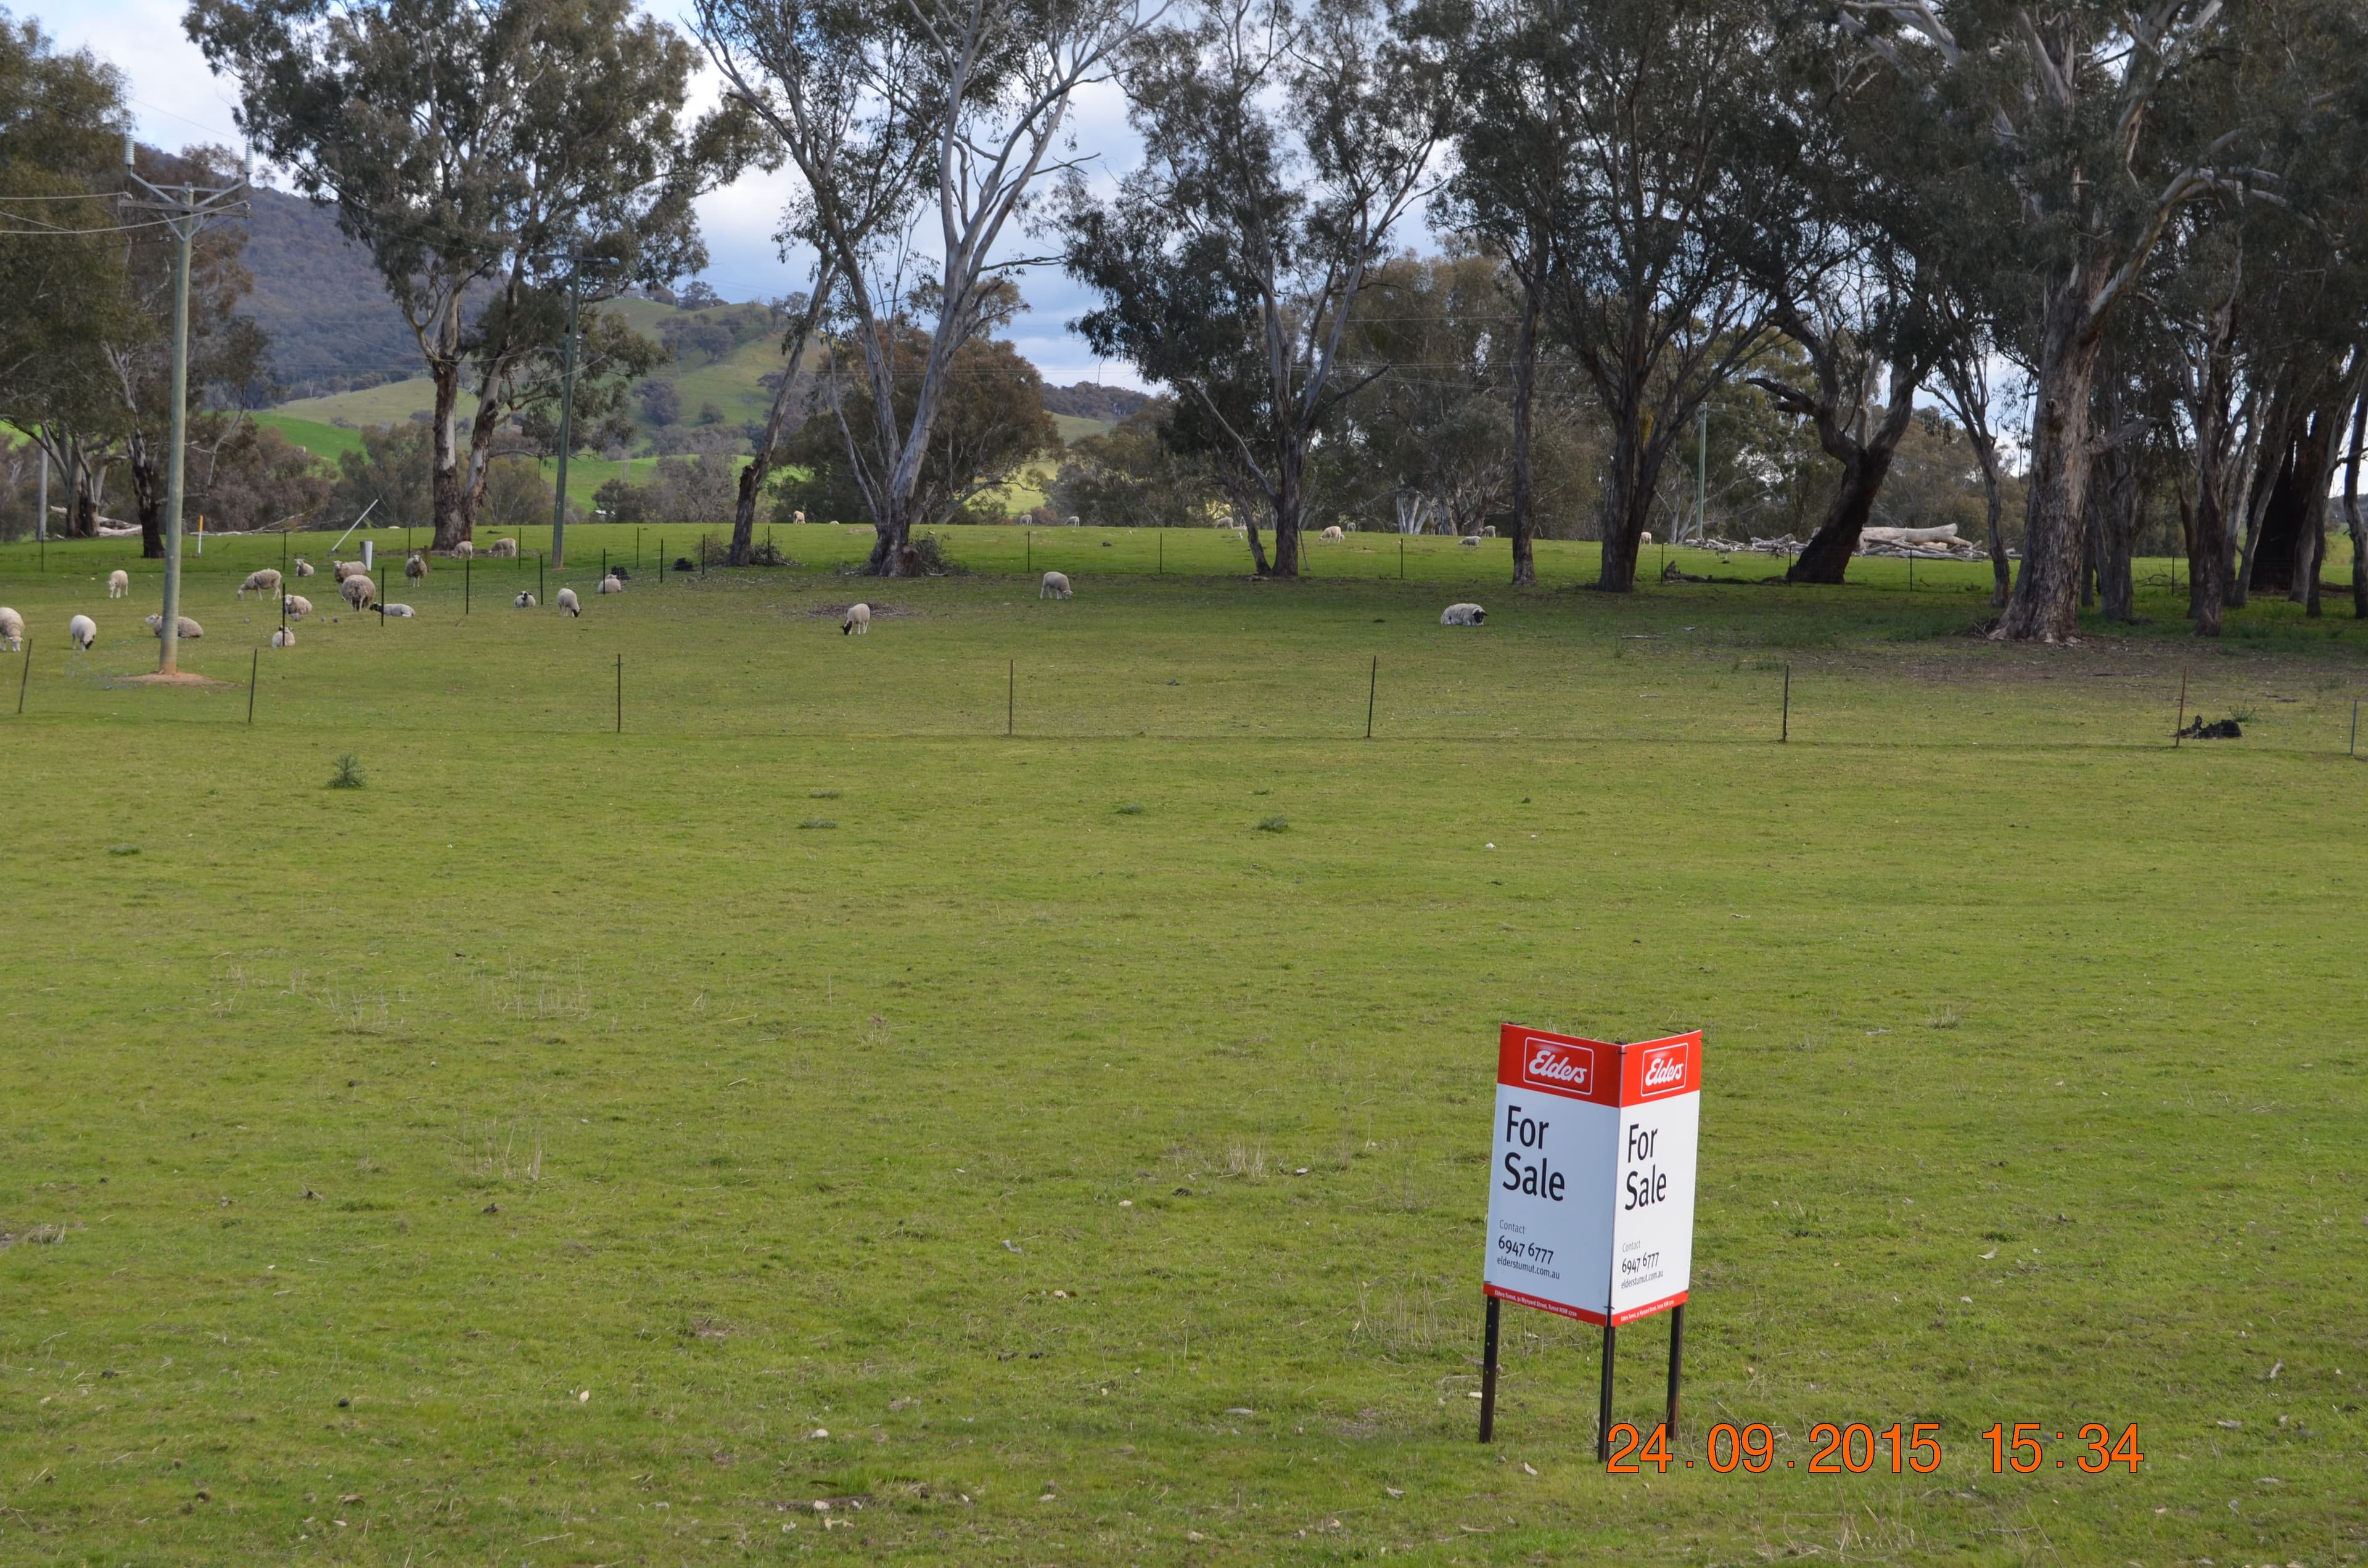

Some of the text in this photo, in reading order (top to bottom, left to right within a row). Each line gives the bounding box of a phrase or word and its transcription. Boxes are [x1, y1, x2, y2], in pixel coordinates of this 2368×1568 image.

[1529, 1050, 1588, 1083] Elders
[1645, 1057, 1684, 1086] Elders
[1507, 1104, 1549, 1149] For
[1628, 1123, 1658, 1163] For
[1502, 1152, 1565, 1201] Sale
[1624, 1164, 1667, 1210] Sale
[1499, 1220, 1525, 1234] Contact
[1498, 1235, 1554, 1265] 6947 6777
[1622, 1240, 1641, 1253] Contact
[1497, 1255, 1560, 1279] elderstumut.com.au
[1622, 1251, 1659, 1276] 6947 6777
[1621, 1270, 1664, 1289] elderstumut.com.au
